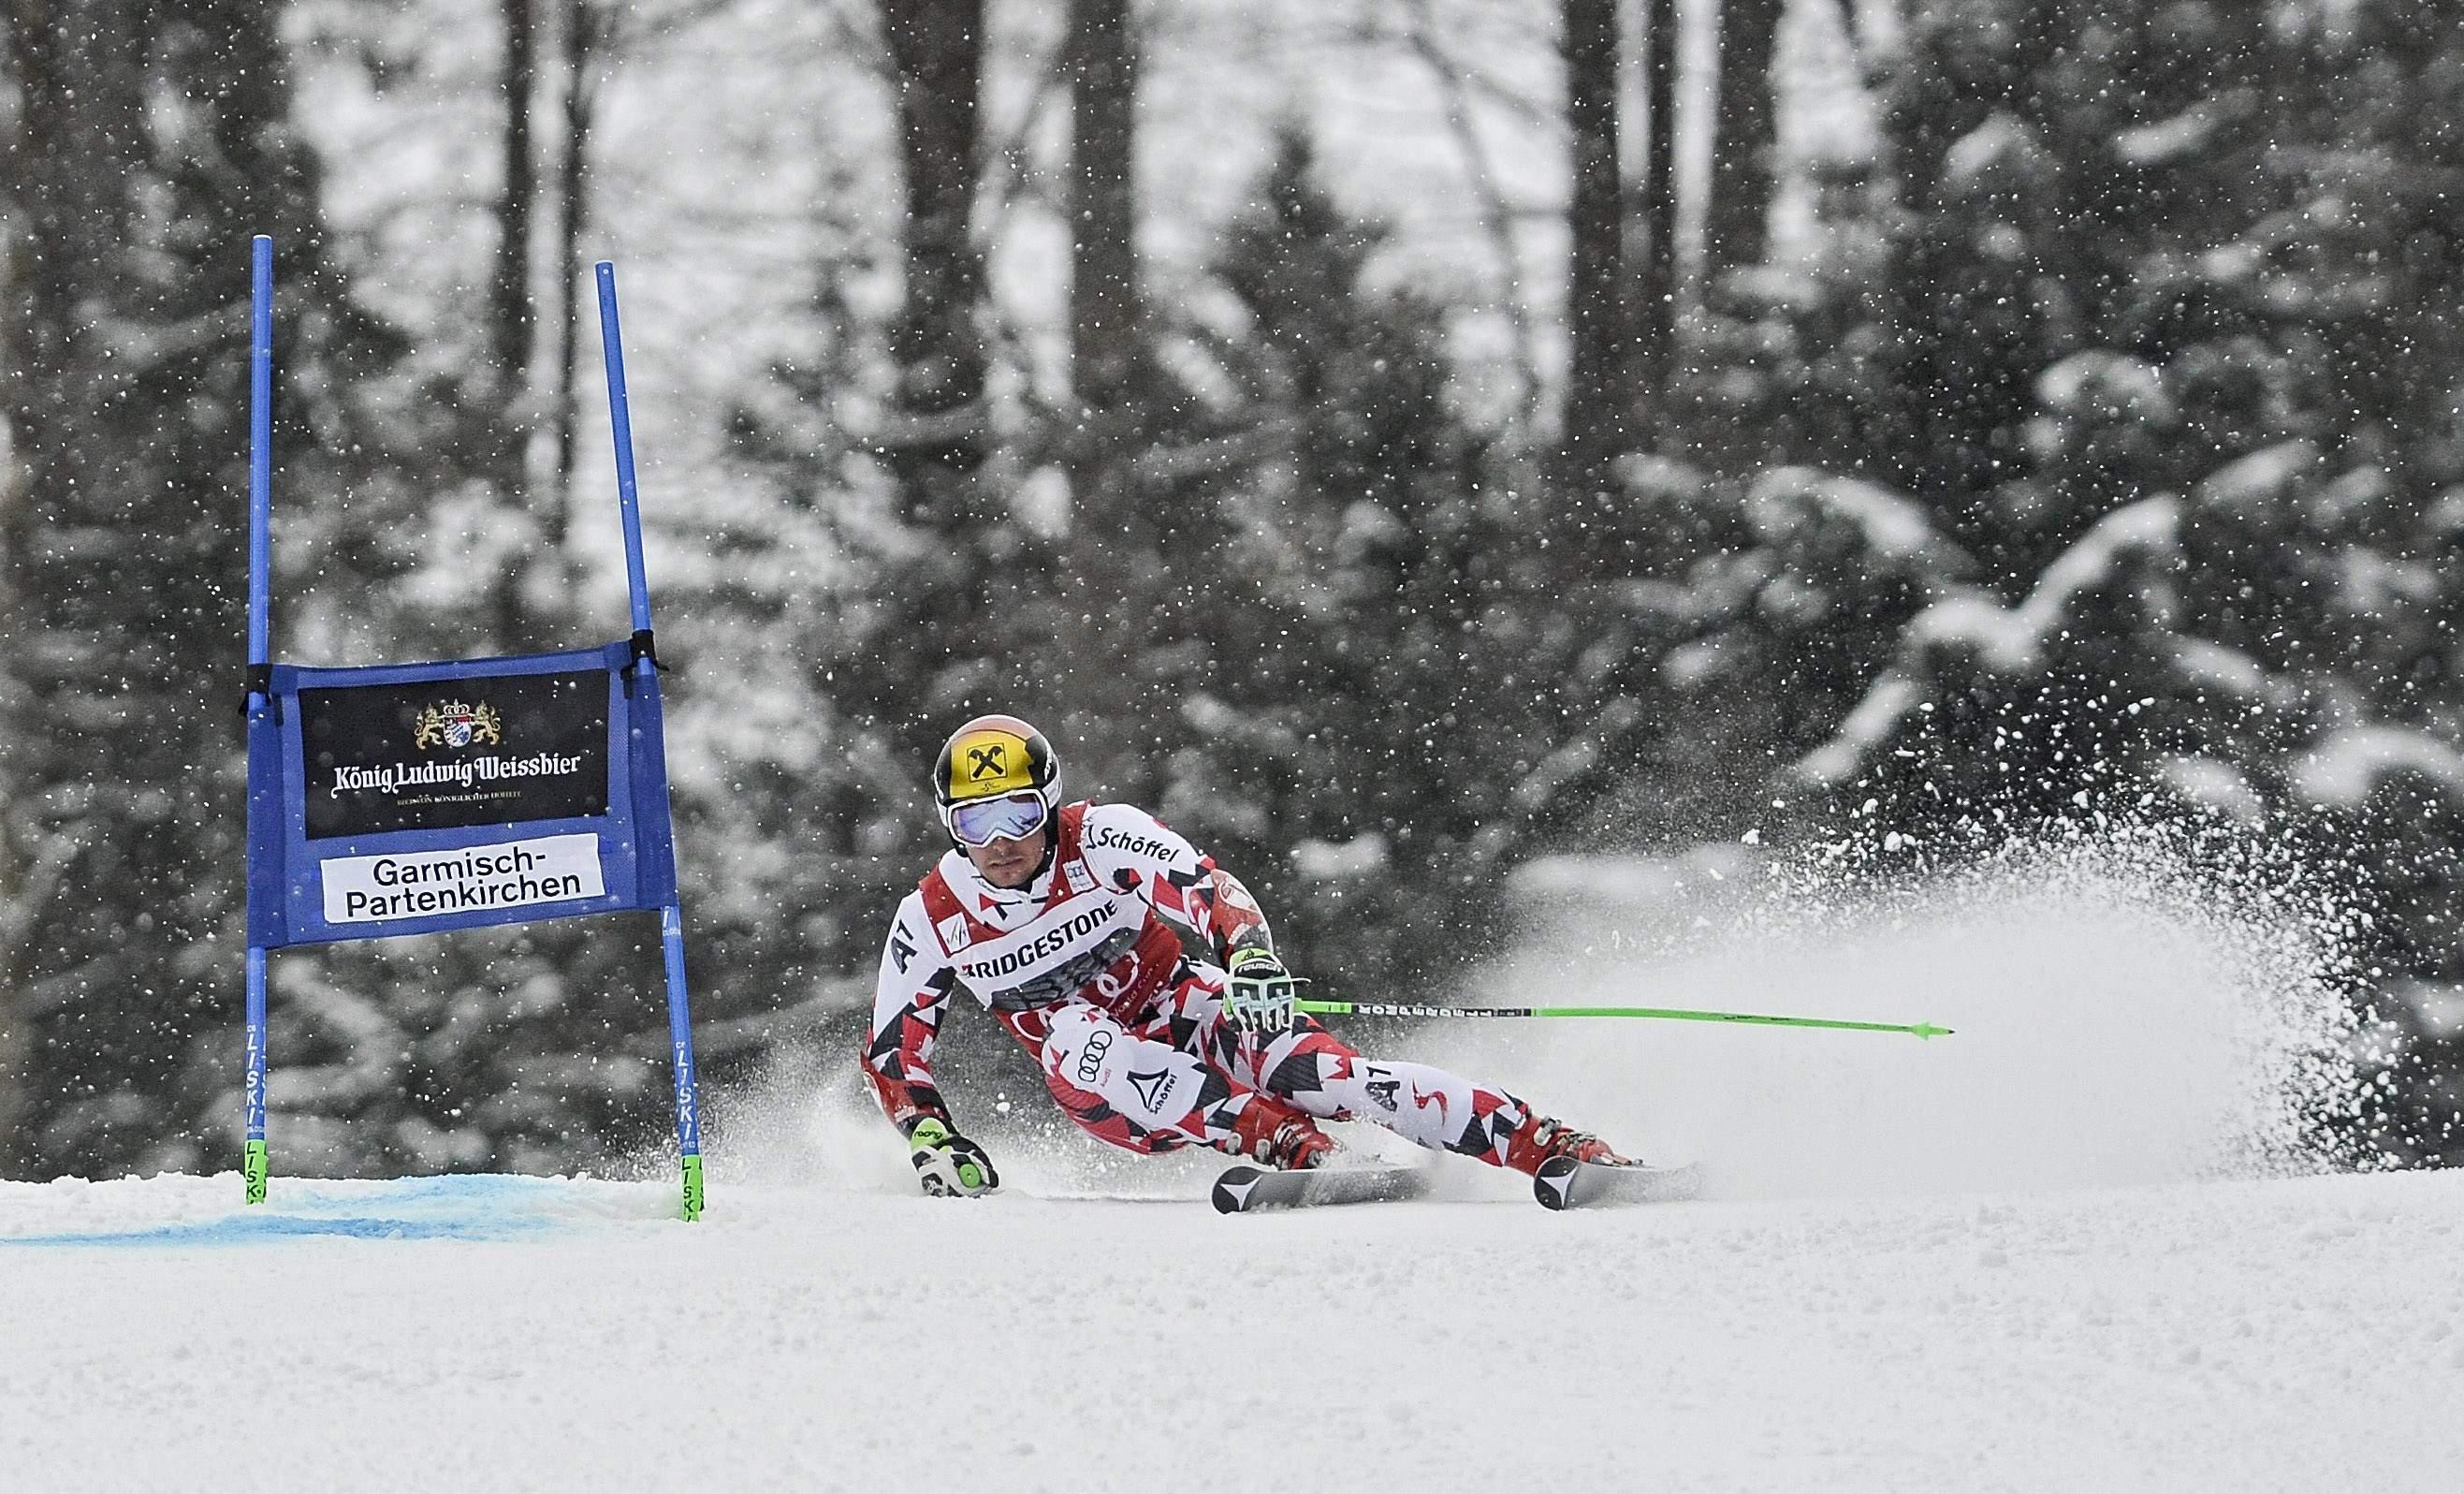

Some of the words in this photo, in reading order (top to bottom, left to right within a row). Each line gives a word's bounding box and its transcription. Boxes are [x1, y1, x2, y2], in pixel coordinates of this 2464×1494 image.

[330, 763, 392, 799] König
[392, 759, 473, 795] Ludwig
[474, 752, 581, 781] Weissbier
[1097, 827, 1179, 862] Schöffel
[373, 846, 547, 886] Garmisch-
[346, 873, 582, 917] Partenkirchen
[1238, 962, 1282, 974] reusch
[1358, 1004, 1493, 1018] KOMPERDELL
[246, 1033, 259, 1124] LISKI
[677, 1049, 693, 1141] LISKI
